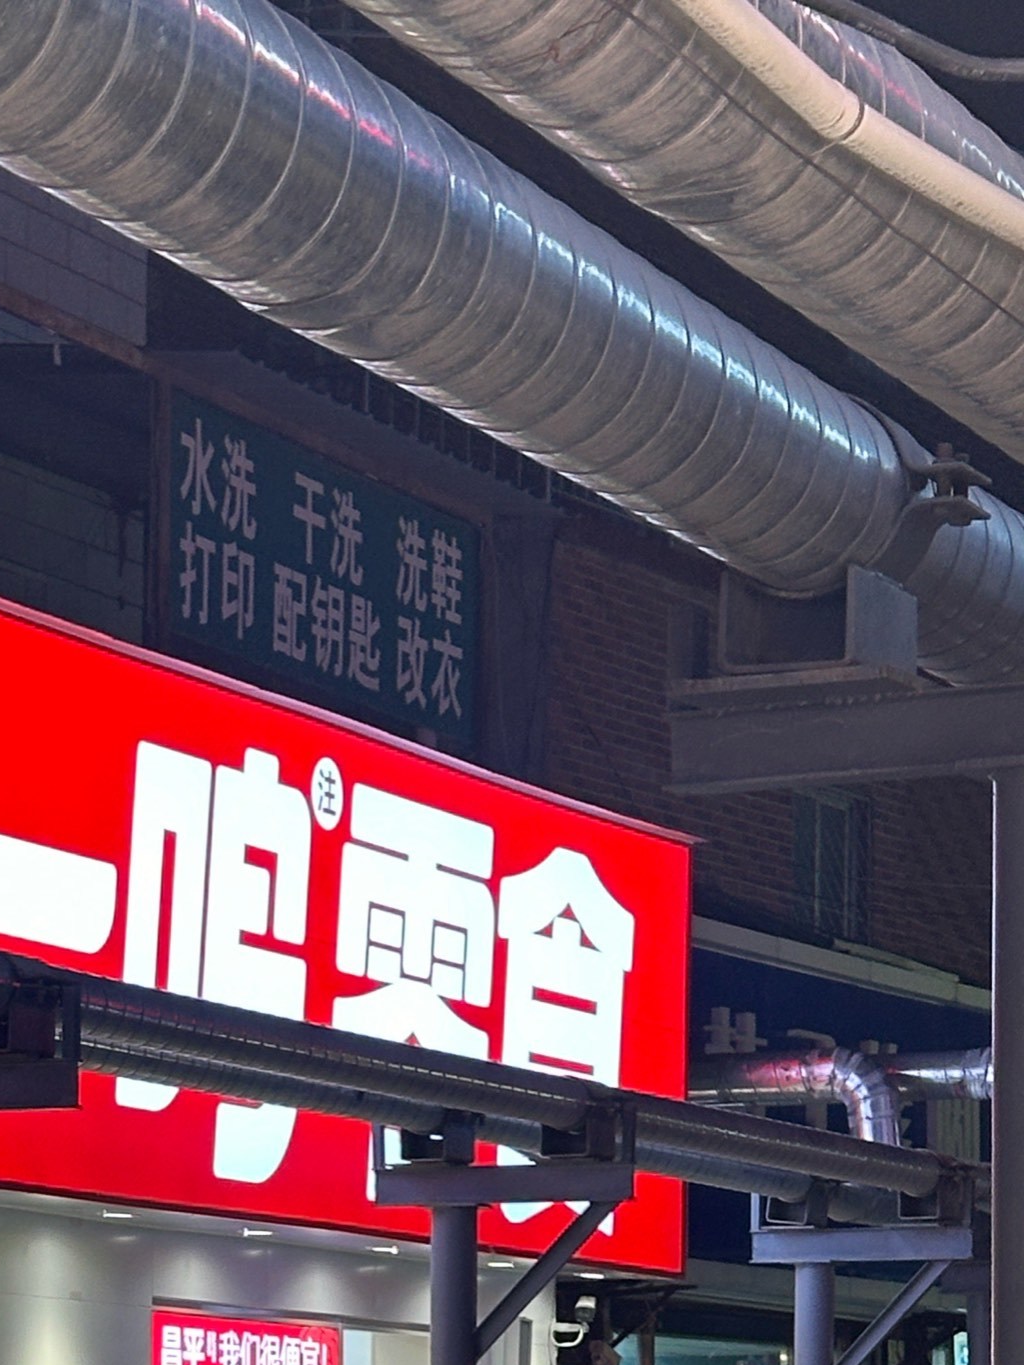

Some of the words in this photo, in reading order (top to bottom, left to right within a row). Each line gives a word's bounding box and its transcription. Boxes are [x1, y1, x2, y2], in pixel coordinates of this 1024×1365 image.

[180, 418, 257, 540] 水洗
[293, 472, 364, 586] 干洗
[396, 516, 463, 624] 洗鞋
[180, 521, 256, 640] 打印
[273, 562, 380, 691] 配钥匙
[396, 616, 464, 719] 改衣
